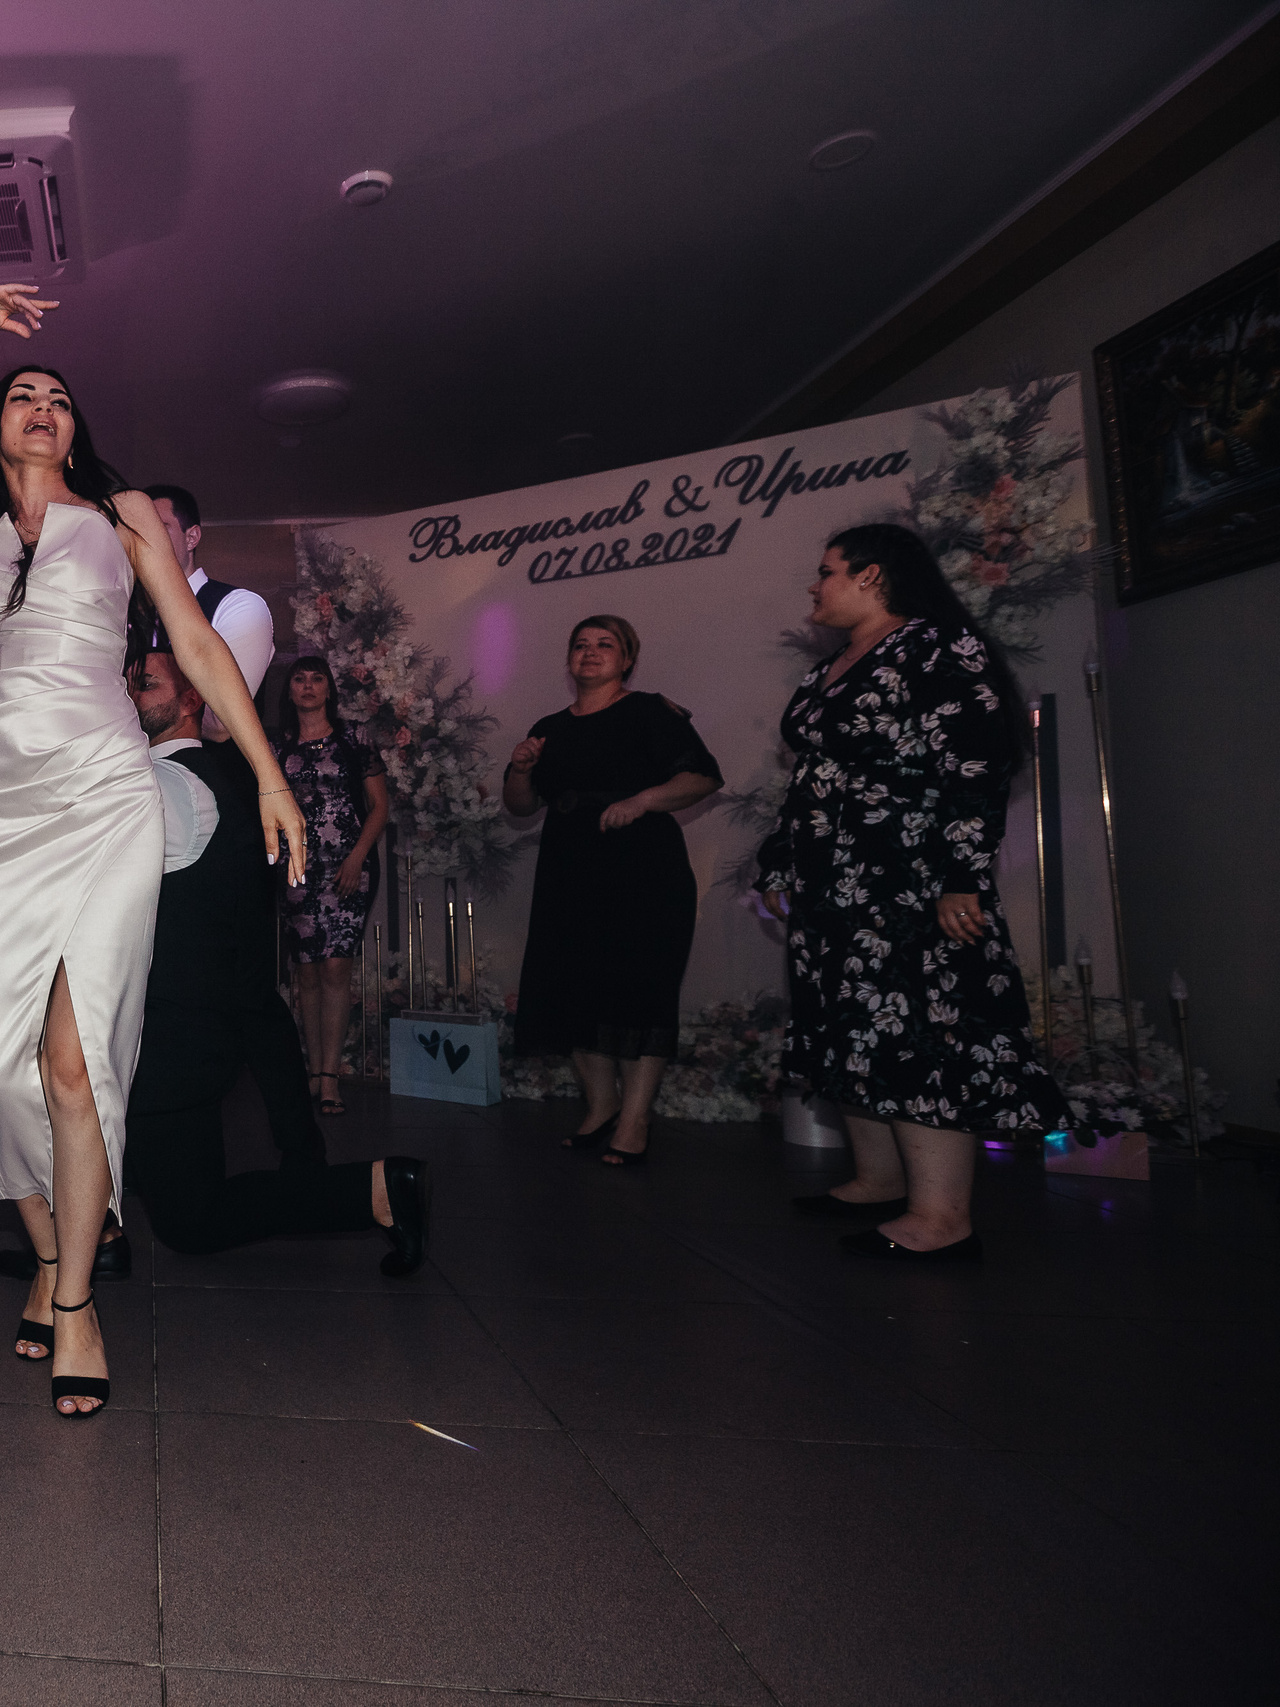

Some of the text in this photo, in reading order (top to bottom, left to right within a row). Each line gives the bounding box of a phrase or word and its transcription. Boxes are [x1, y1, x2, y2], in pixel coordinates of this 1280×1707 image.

[409, 447, 912, 566] Владислав & Ирина
[528, 518, 742, 584] 07.08.2021
